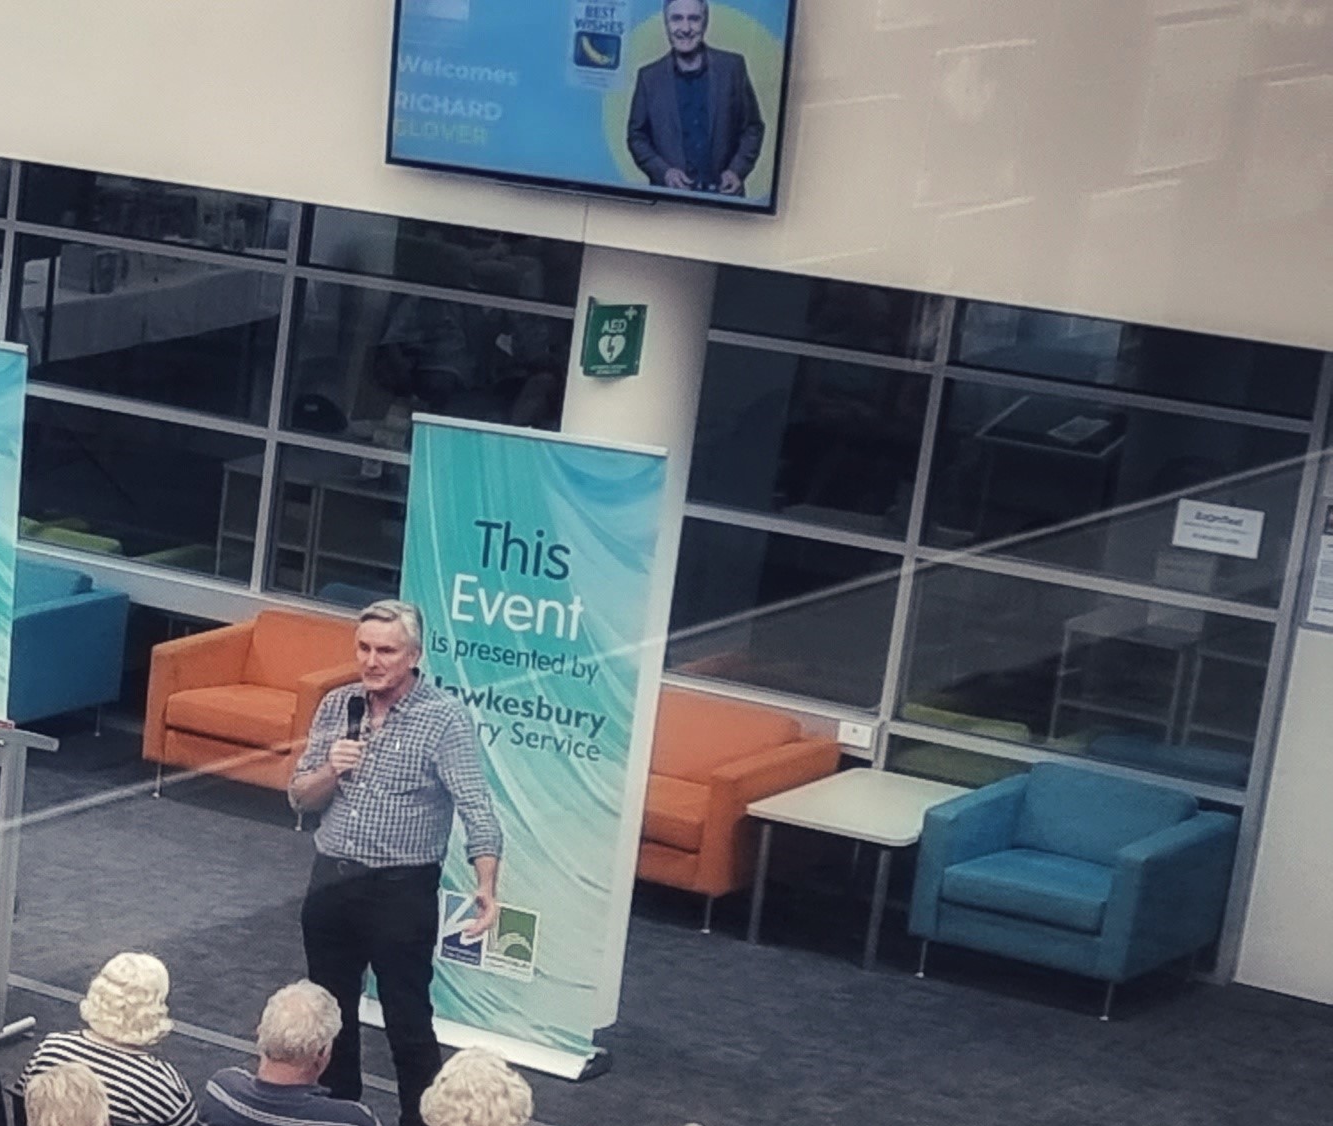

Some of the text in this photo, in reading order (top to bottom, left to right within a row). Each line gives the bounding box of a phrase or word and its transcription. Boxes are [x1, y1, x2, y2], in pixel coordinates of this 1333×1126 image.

[574, 17, 624, 35] WISHES
[585, 5, 615, 19] BEST
[397, 54, 518, 86] Welcomes
[396, 90, 503, 121] RICHARD
[601, 318, 627, 334] AED
[474, 520, 572, 581] This
[451, 573, 584, 642] Event
[431, 630, 600, 686] is presented by
[510, 721, 602, 762] Service
